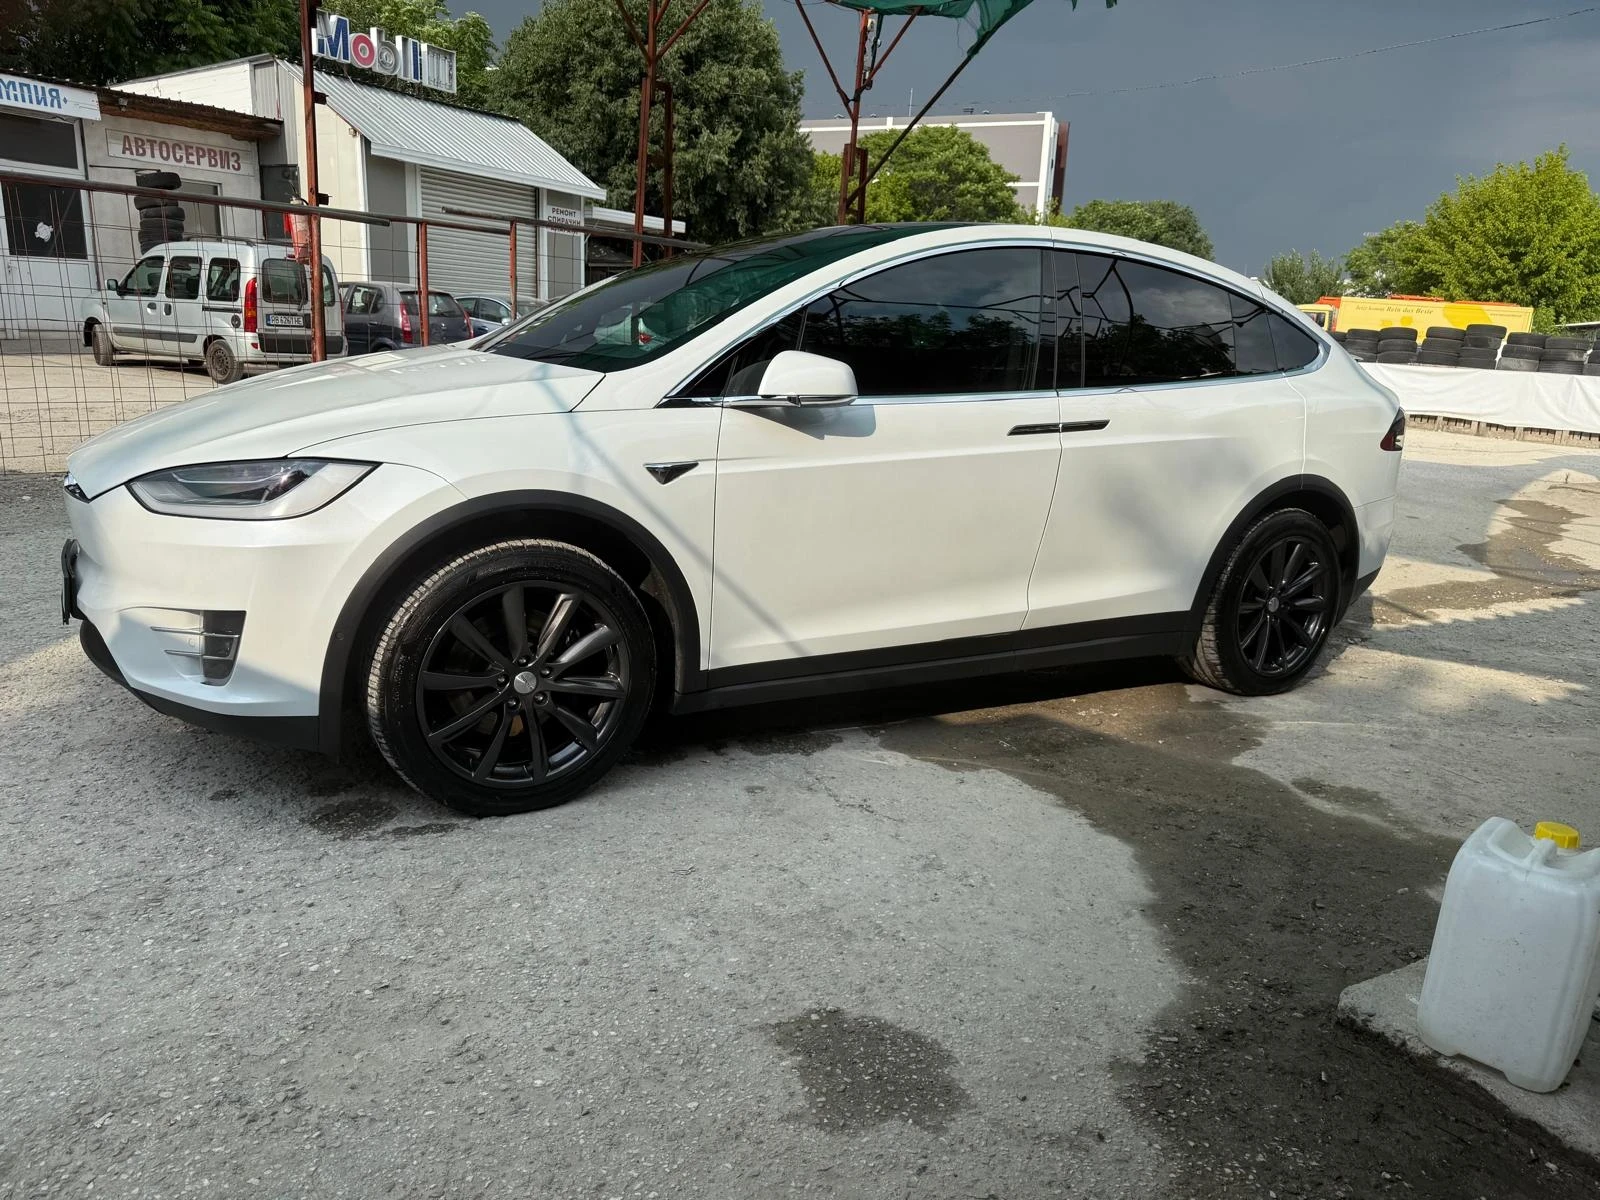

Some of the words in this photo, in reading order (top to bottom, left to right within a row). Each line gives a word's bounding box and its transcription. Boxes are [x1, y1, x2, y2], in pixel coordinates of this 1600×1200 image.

[312, 8, 420, 83] Mobil
[122, 135, 241, 171] АВТОСЕРВИЗ
[552, 208, 576, 217] РЕМОНТ
